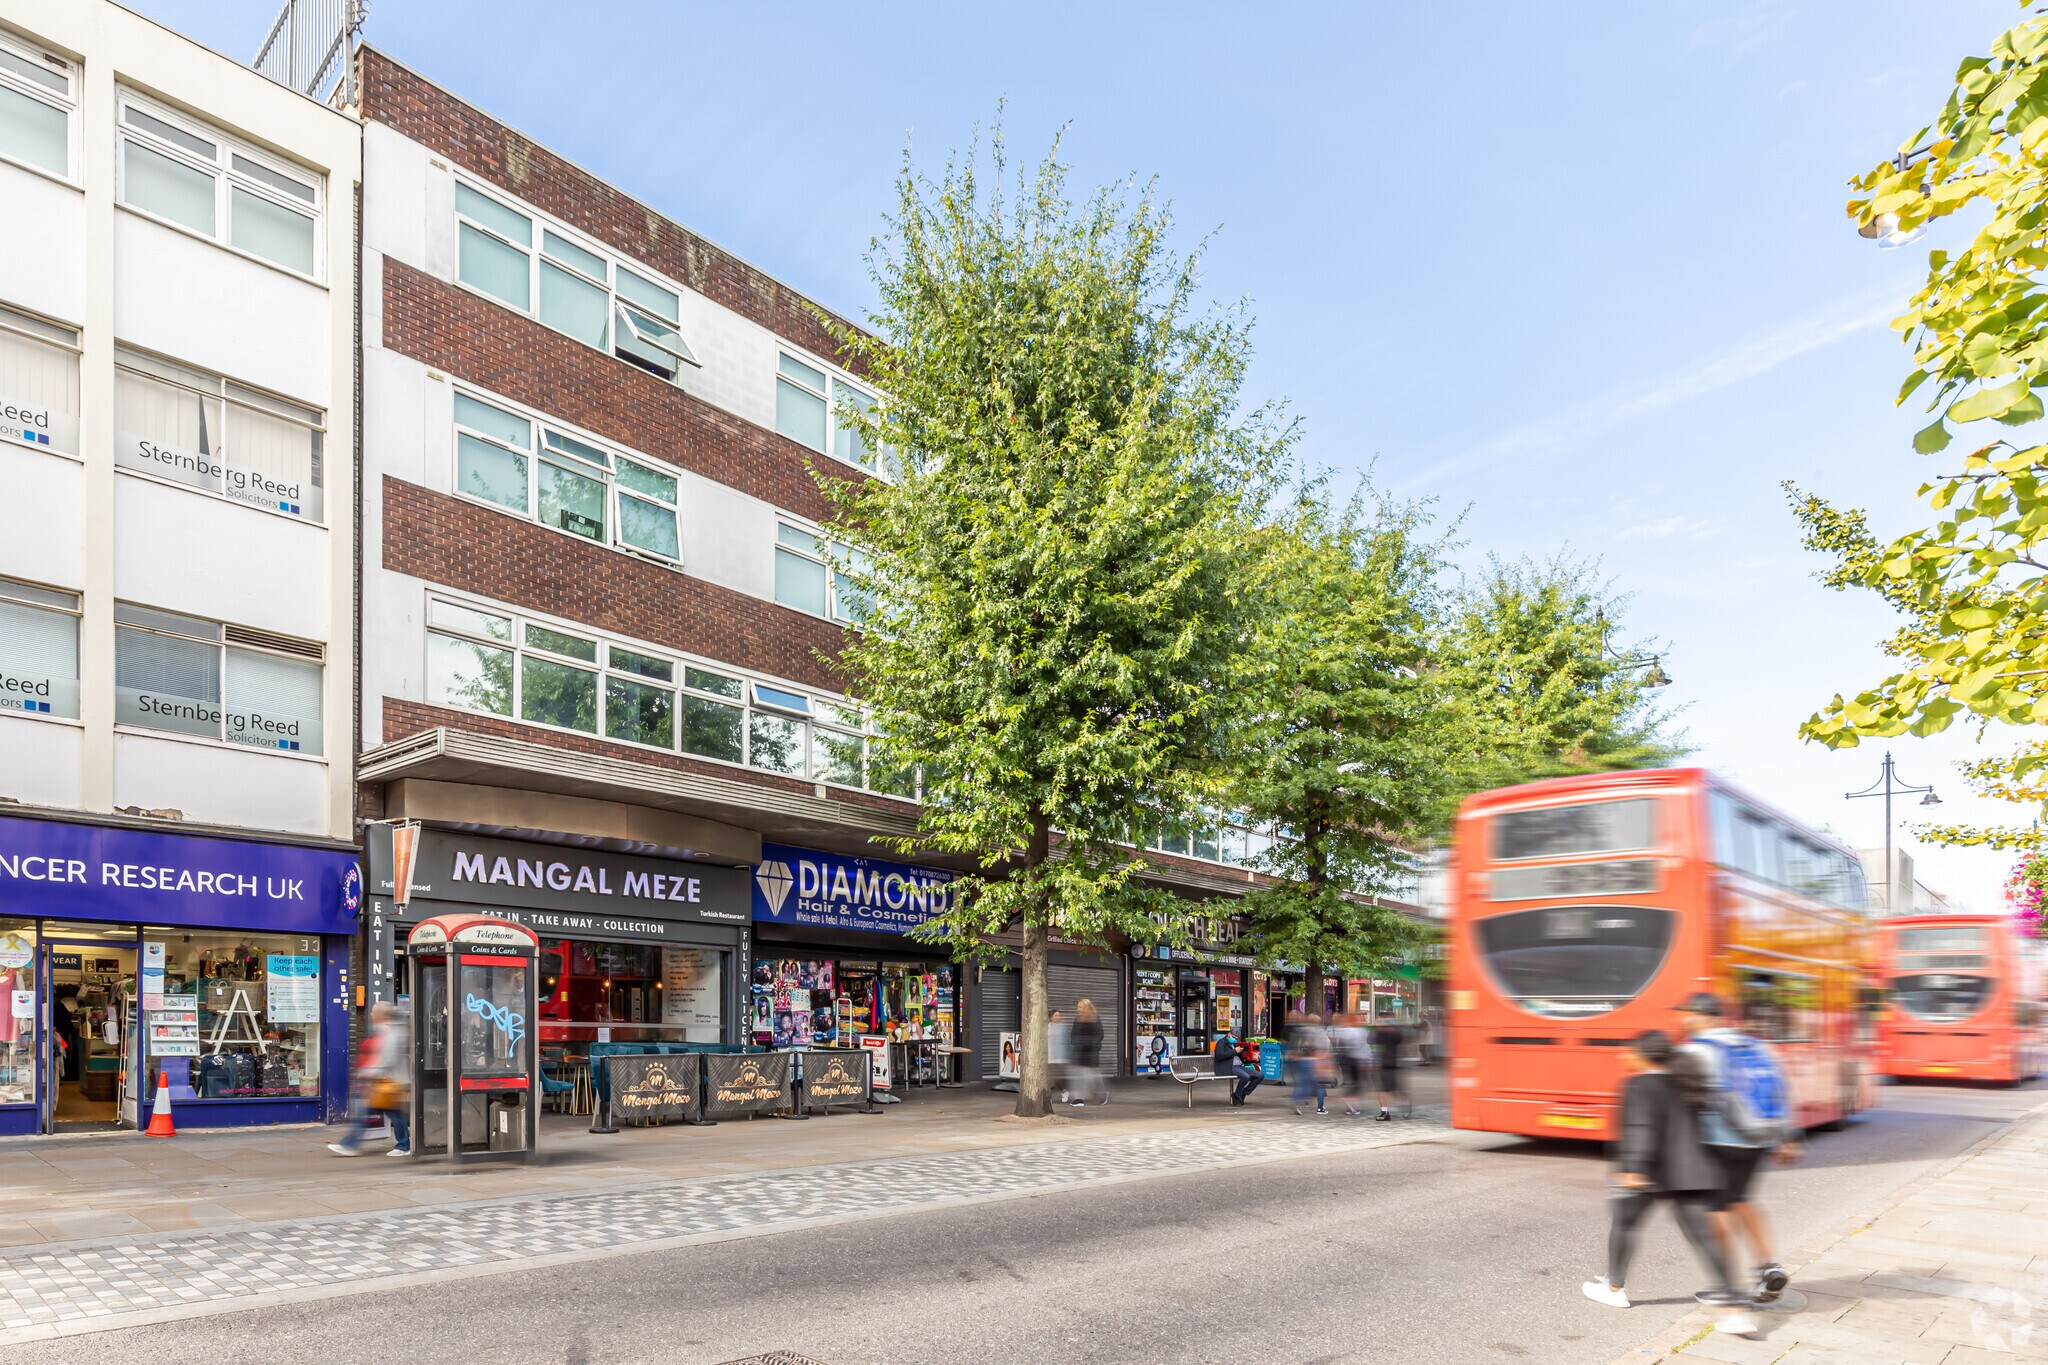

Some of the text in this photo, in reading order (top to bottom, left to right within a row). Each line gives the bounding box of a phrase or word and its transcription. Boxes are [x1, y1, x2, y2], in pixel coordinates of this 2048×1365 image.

[0, 401, 49, 428] eed
[139, 441, 299, 500] Sternberg Reed
[227, 487, 278, 509] Solicitors
[0, 673, 49, 696] eed
[139, 695, 299, 736] Sternberg Reed
[227, 731, 277, 747] Solicitors
[0, 855, 304, 901] NCER RESEARCH UK
[452, 851, 701, 903] MANGAL MEZE
[381, 880, 431, 892] Full ensed
[800, 859, 947, 914] DIAMOND
[700, 910, 745, 920] Turkish Restaurant
[798, 899, 833, 913] Hair
[839, 904, 850, 915] &
[373, 901, 382, 941] EAT
[507, 912, 520, 922] IN
[531, 914, 559, 926] TAKE
[562, 916, 593, 929] AWAY
[603, 920, 664, 934] COLLECTION
[796, 911, 811, 923] Whole
[811, 914, 821, 923] sale
[853, 918, 874, 930] European
[476, 930, 514, 940] Telephone
[498, 947, 518, 955] Cards
[274, 957, 312, 966] Keep each
[296, 965, 312, 973] safe!
[717, 1089, 781, 1104] Mangal Meze
[811, 1084, 863, 1098] Mangal Meze
[622, 1093, 690, 1109] Mangal Meze
